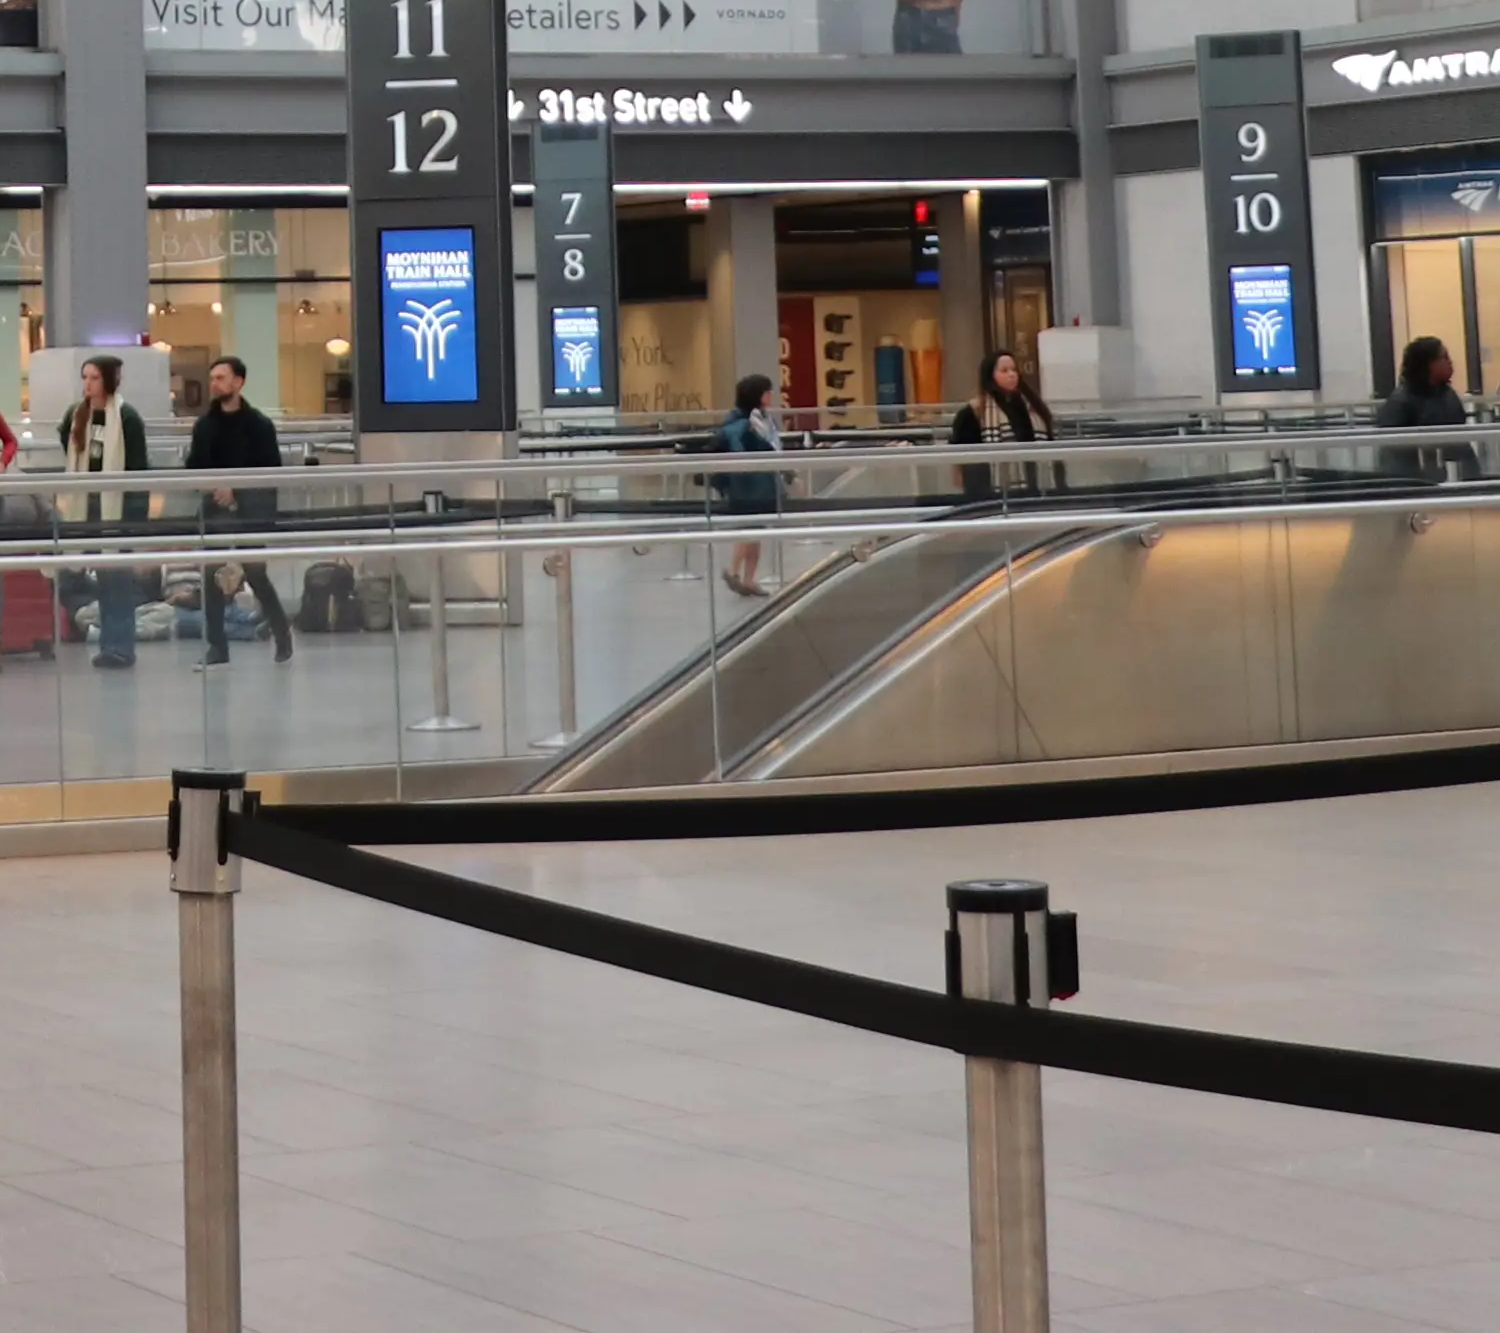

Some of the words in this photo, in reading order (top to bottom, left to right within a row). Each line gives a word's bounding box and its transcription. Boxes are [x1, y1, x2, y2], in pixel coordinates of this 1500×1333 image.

[716, 9, 786, 20] VORNADO
[539, 89, 607, 123] 31st
[612, 89, 711, 123] Street
[387, 109, 459, 173] 12
[1237, 122, 1266, 162] 9
[561, 193, 583, 225] 7
[1234, 192, 1281, 233] 10
[161, 230, 283, 258] BAKERY
[387, 251, 469, 266] MOYNIHAN
[386, 265, 431, 280] TRAIN
[434, 264, 472, 278] HALL
[563, 248, 585, 281] 8
